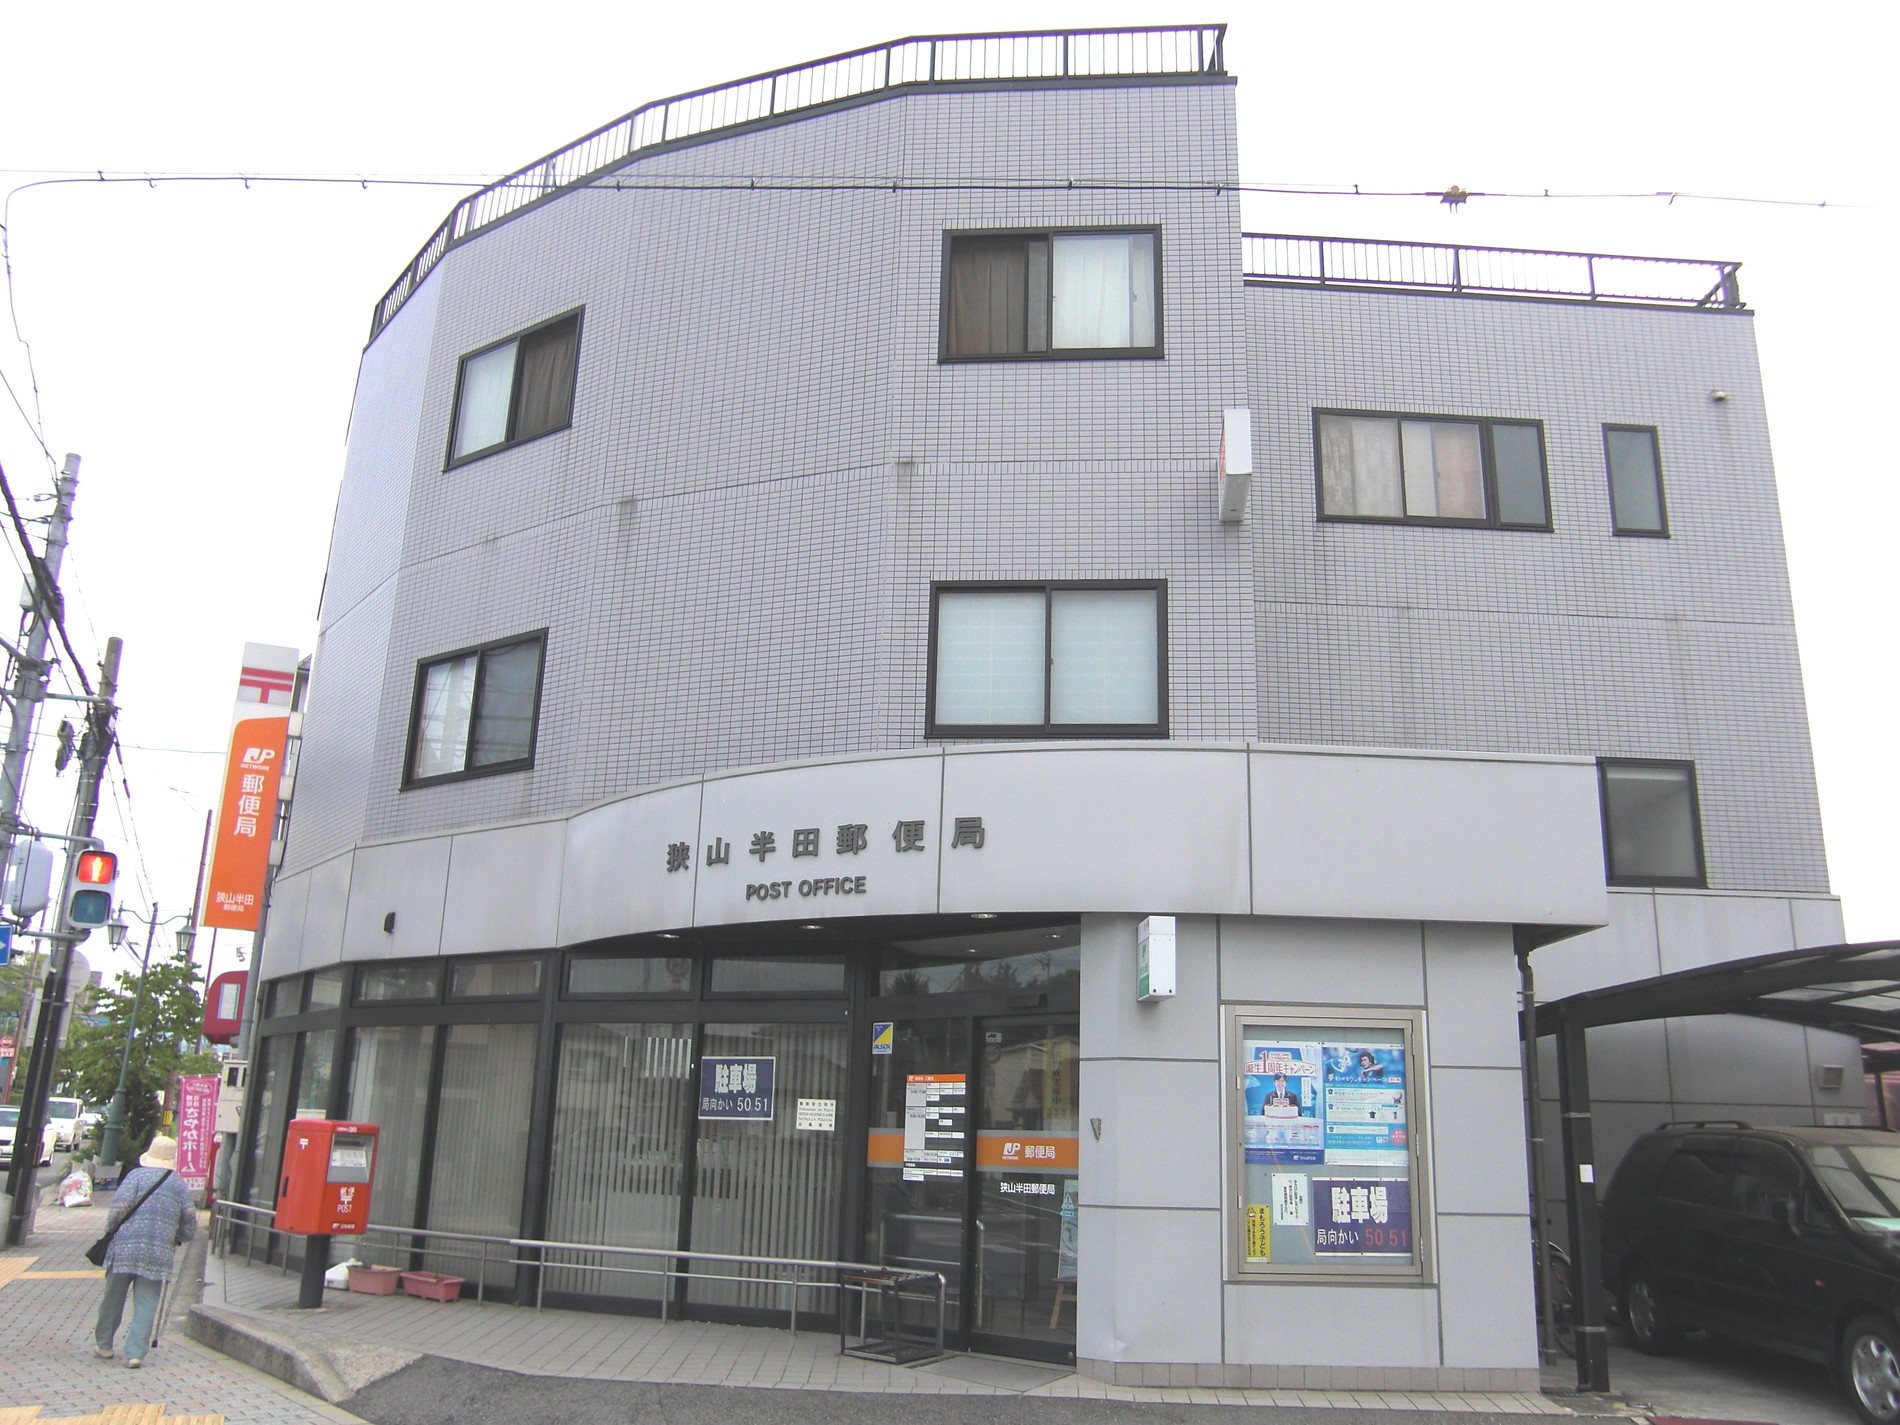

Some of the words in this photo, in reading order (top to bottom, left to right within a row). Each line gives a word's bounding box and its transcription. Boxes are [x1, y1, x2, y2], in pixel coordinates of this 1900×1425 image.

[234, 774, 264, 838] 郵便局
[666, 816, 986, 873] 狭山半田郵便局
[746, 880, 792, 901] POST
[798, 875, 867, 897] OFFICE
[216, 891, 254, 906] 狭山半田
[714, 1063, 757, 1094] 駐車場
[702, 1098, 733, 1111] 局向かい
[737, 1098, 751, 1112] 50
[754, 1098, 768, 1112] 51
[1025, 1146, 1056, 1159] 郵便局
[1000, 1182, 1055, 1195] 狭山半田郵便局
[337, 1204, 352, 1213] POST
[1331, 1186, 1388, 1224] 駐車場
[1317, 1229, 1359, 1245] 局向かい
[1365, 1228, 1383, 1246] 50
[1389, 1229, 1407, 1246] 51
